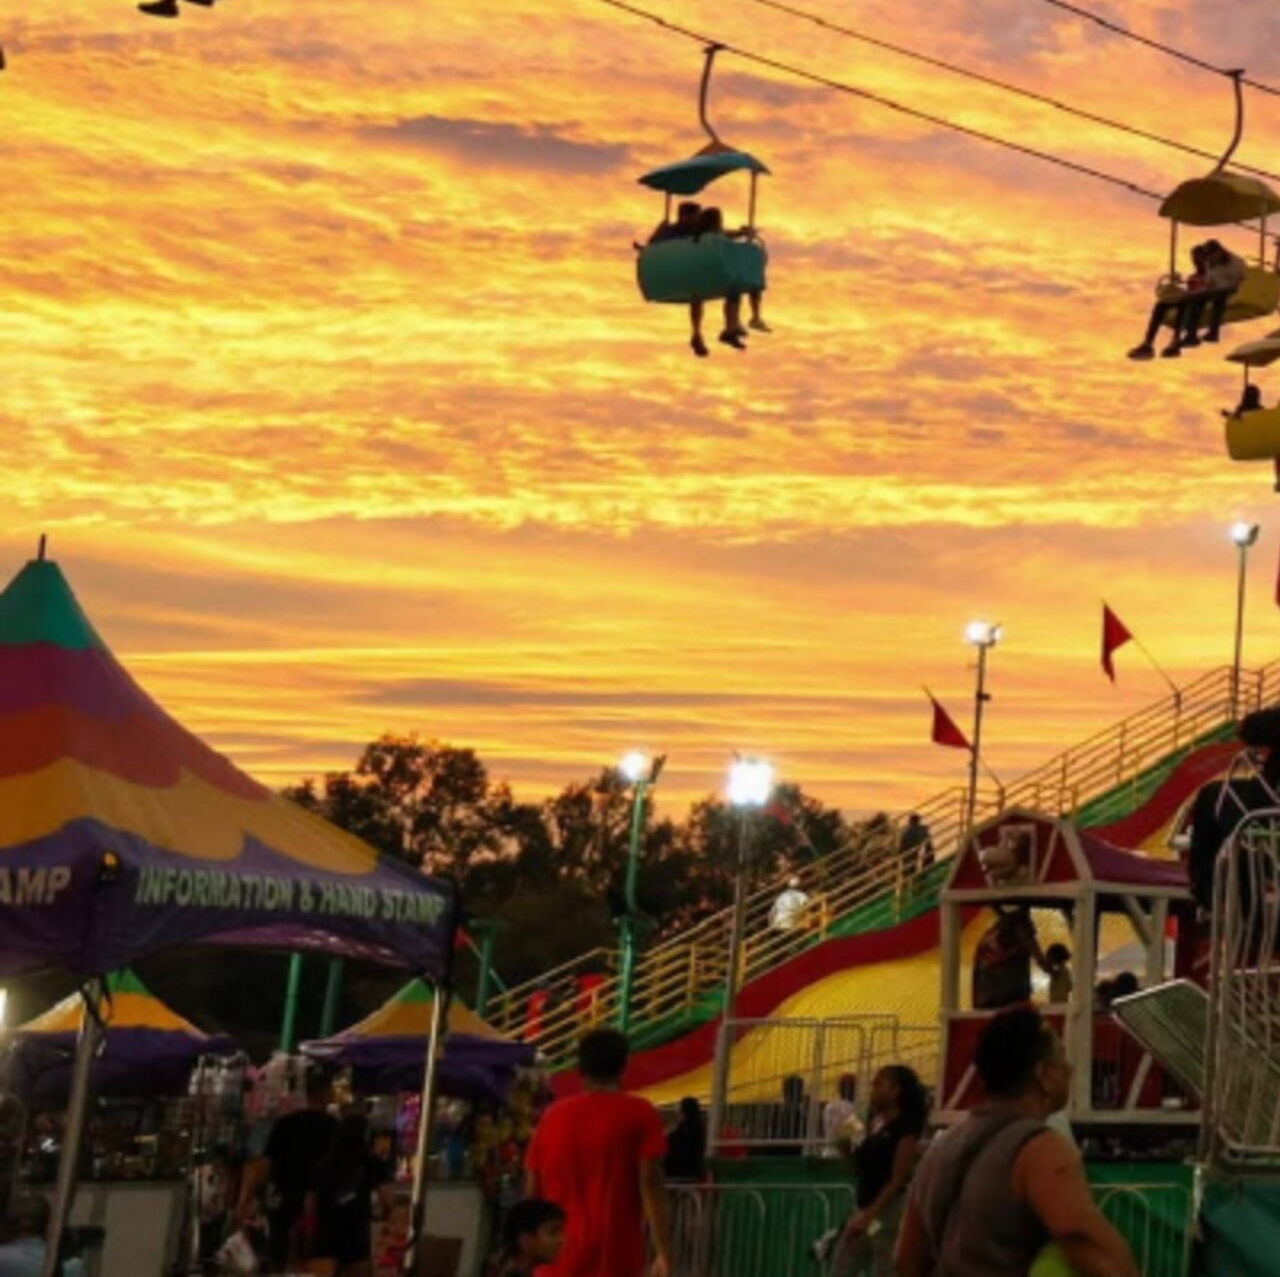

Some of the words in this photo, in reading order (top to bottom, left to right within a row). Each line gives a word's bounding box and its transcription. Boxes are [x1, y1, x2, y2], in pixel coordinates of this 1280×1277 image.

[134, 866, 293, 910] INFORMATION
[301, 879, 315, 912] &
[320, 882, 376, 918] HAND
[381, 888, 446, 926] STAMP
